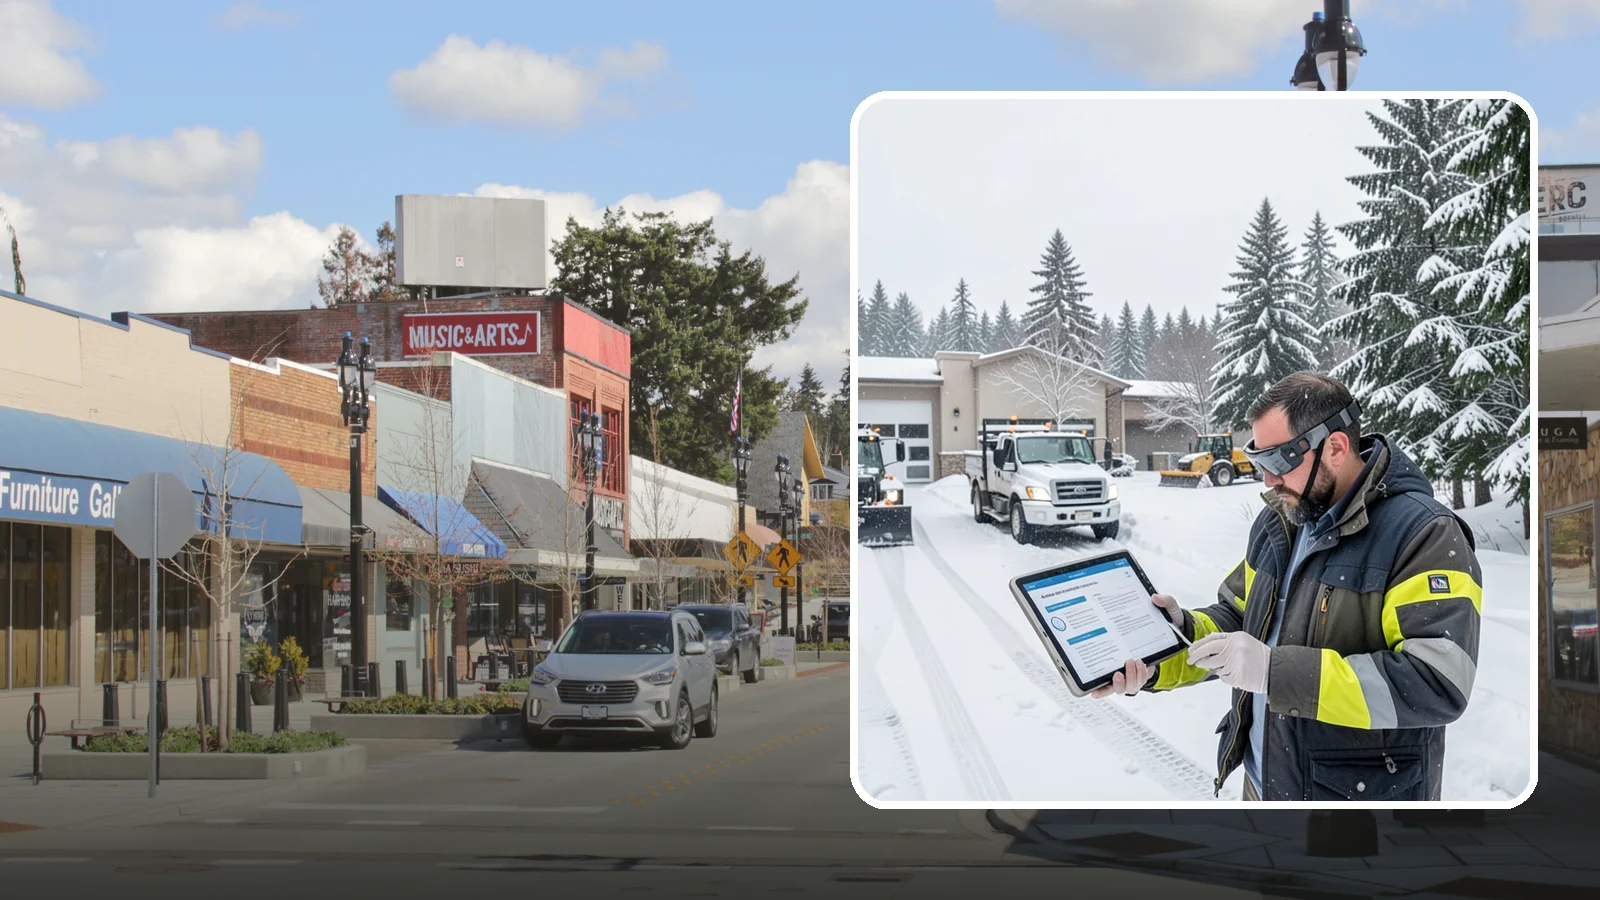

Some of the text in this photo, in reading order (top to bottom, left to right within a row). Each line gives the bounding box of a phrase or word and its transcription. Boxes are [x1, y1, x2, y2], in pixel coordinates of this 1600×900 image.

[409, 323, 519, 348] MUSIC&ARTS
[0, 471, 79, 515] Furniture
[453, 563, 479, 574] SUSHI
